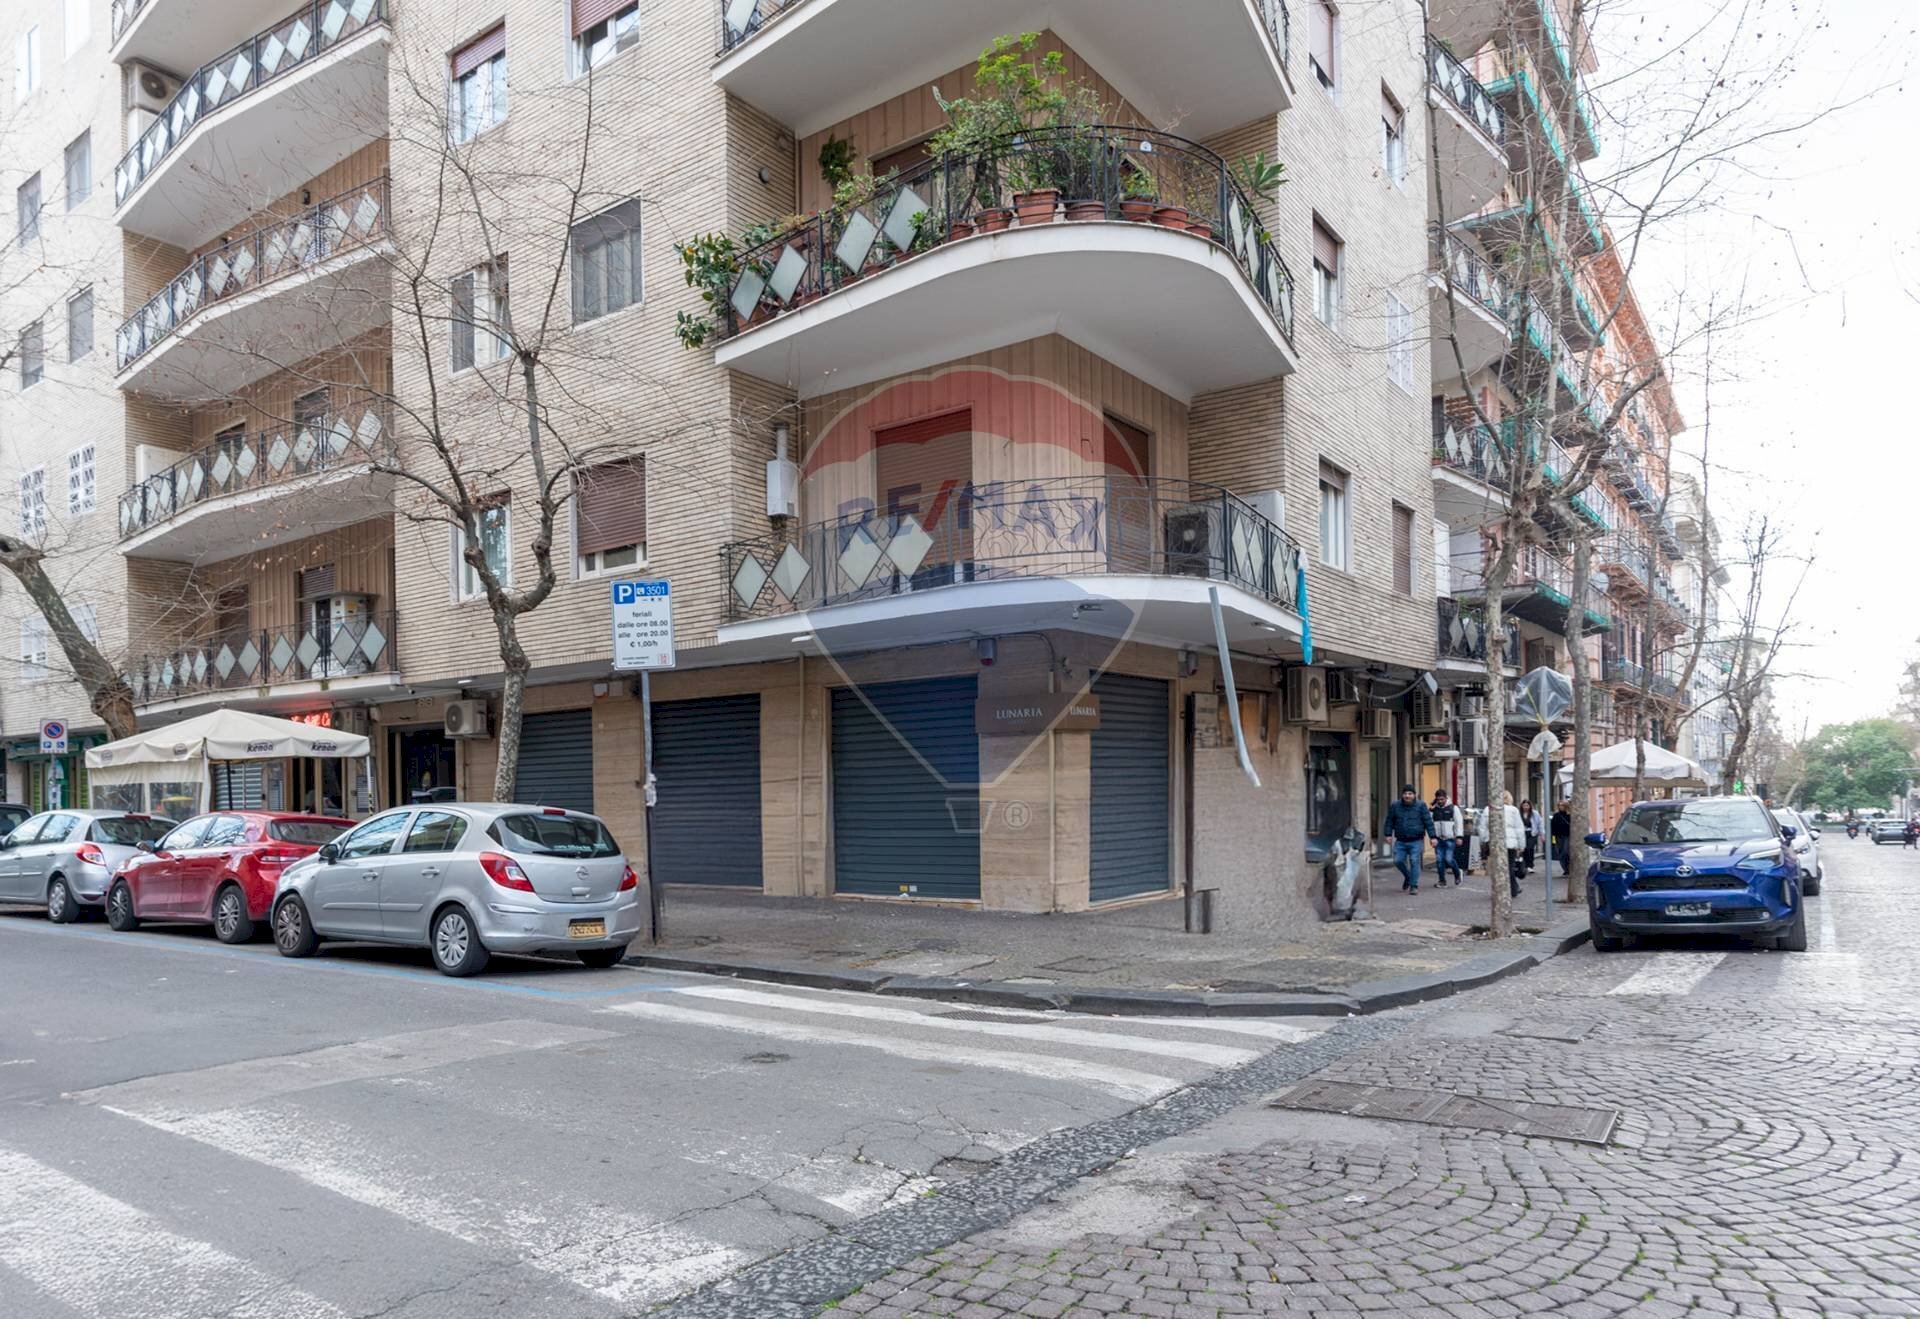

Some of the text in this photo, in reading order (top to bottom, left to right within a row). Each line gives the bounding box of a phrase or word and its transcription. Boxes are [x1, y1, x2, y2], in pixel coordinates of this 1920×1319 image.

[619, 585, 665, 602] P 3501
[996, 708, 1043, 719] LUNARIA
[1070, 706, 1097, 716] LUNARIA
